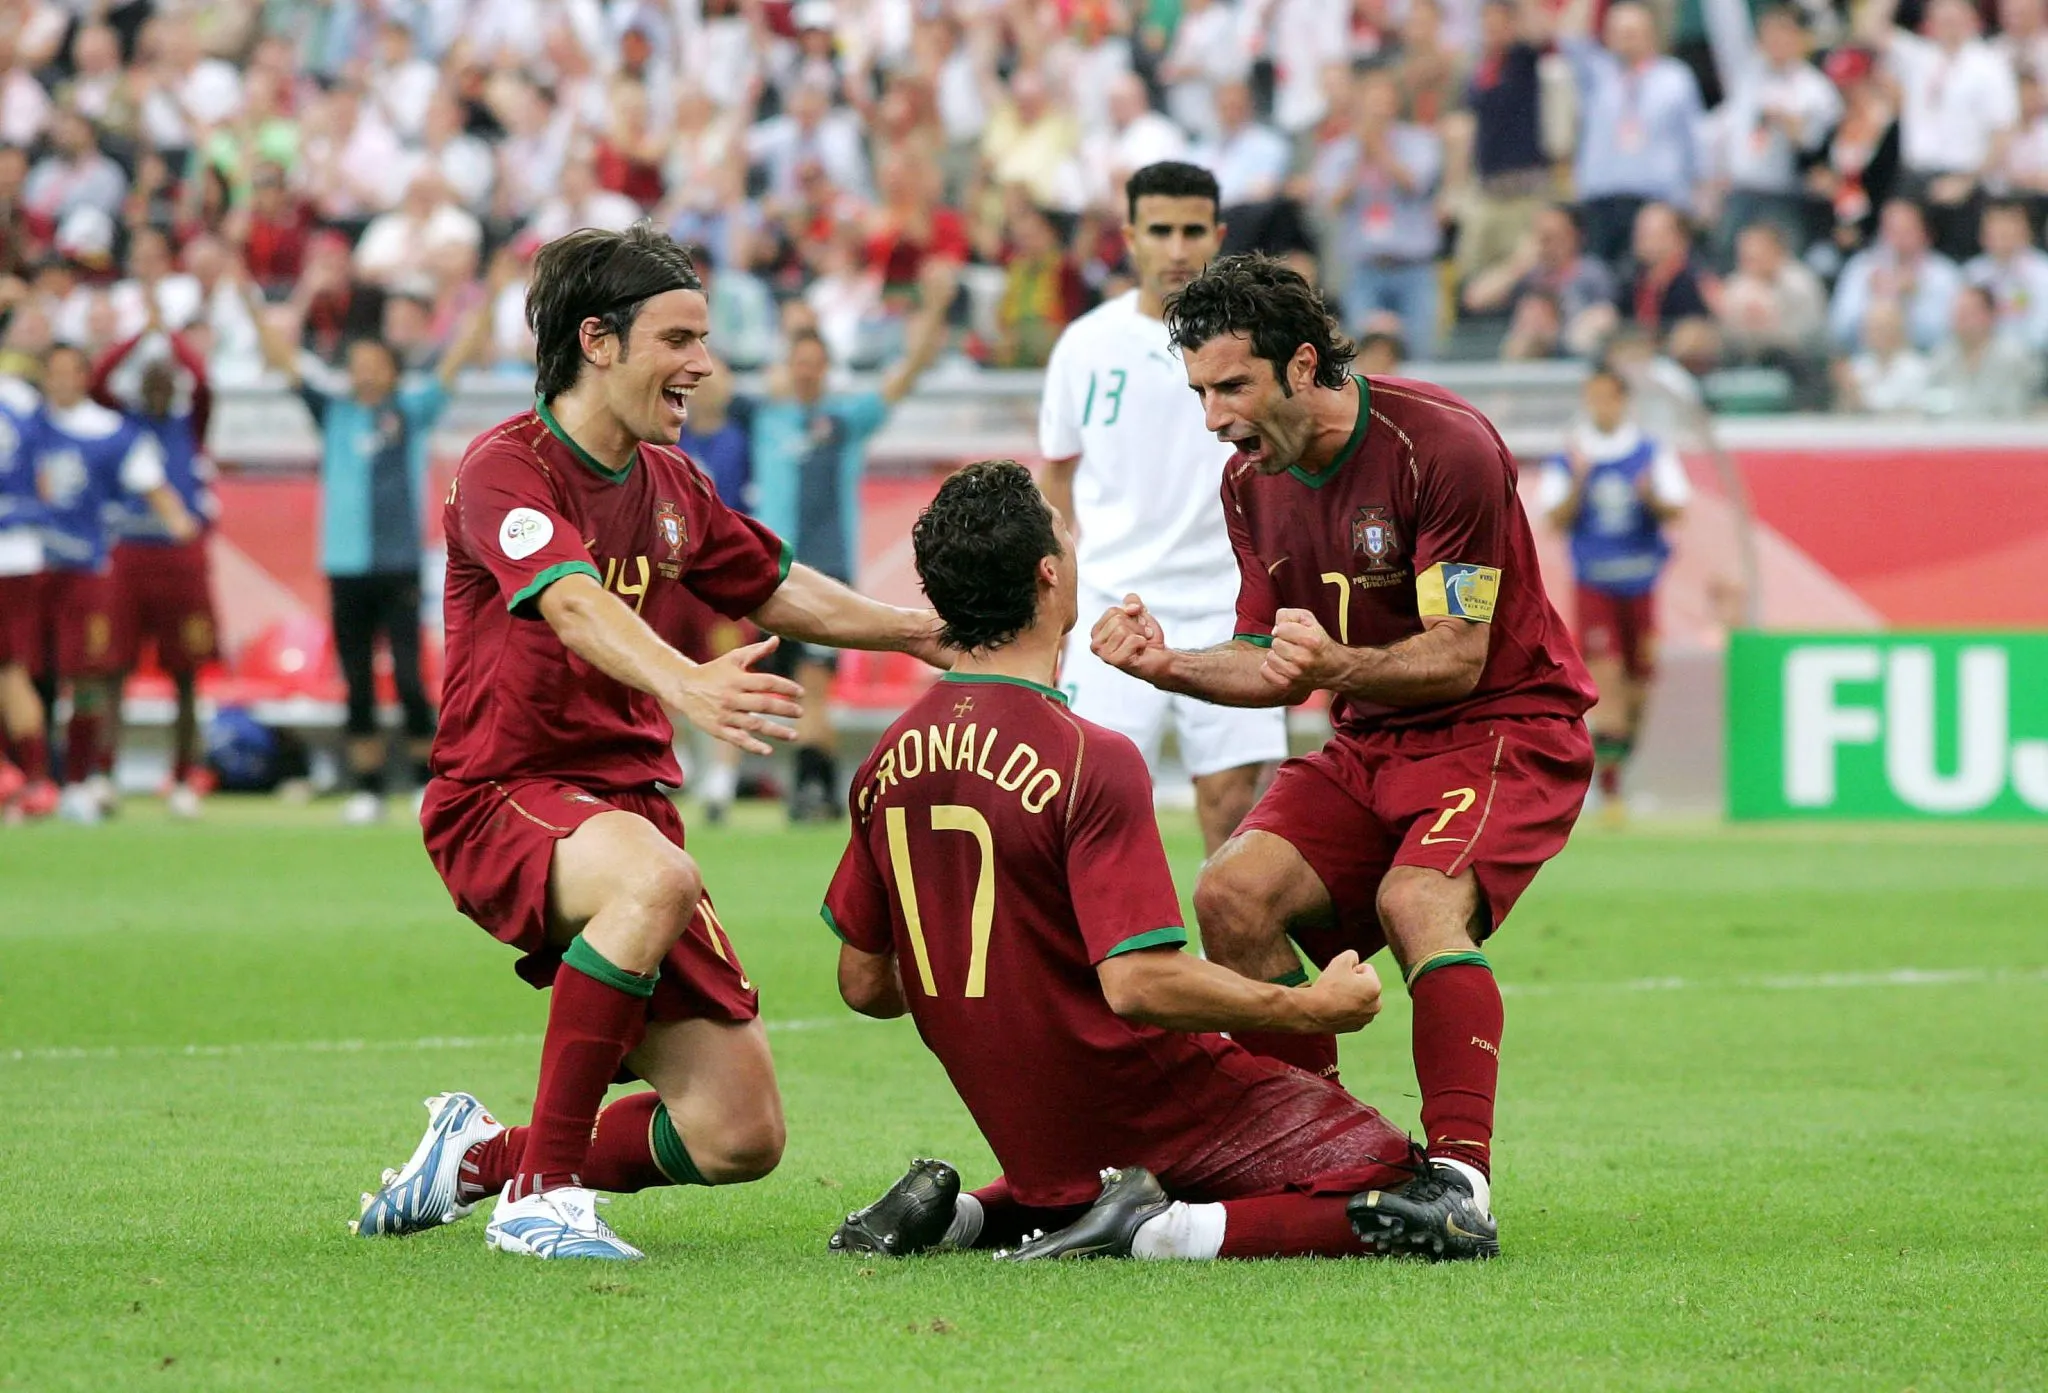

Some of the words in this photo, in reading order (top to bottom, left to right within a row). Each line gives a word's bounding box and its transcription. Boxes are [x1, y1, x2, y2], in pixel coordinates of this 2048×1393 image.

[1082, 368, 1127, 427] 13
[602, 555, 650, 616] 14
[1320, 571, 1351, 645] 7
[885, 804, 996, 998] 17
